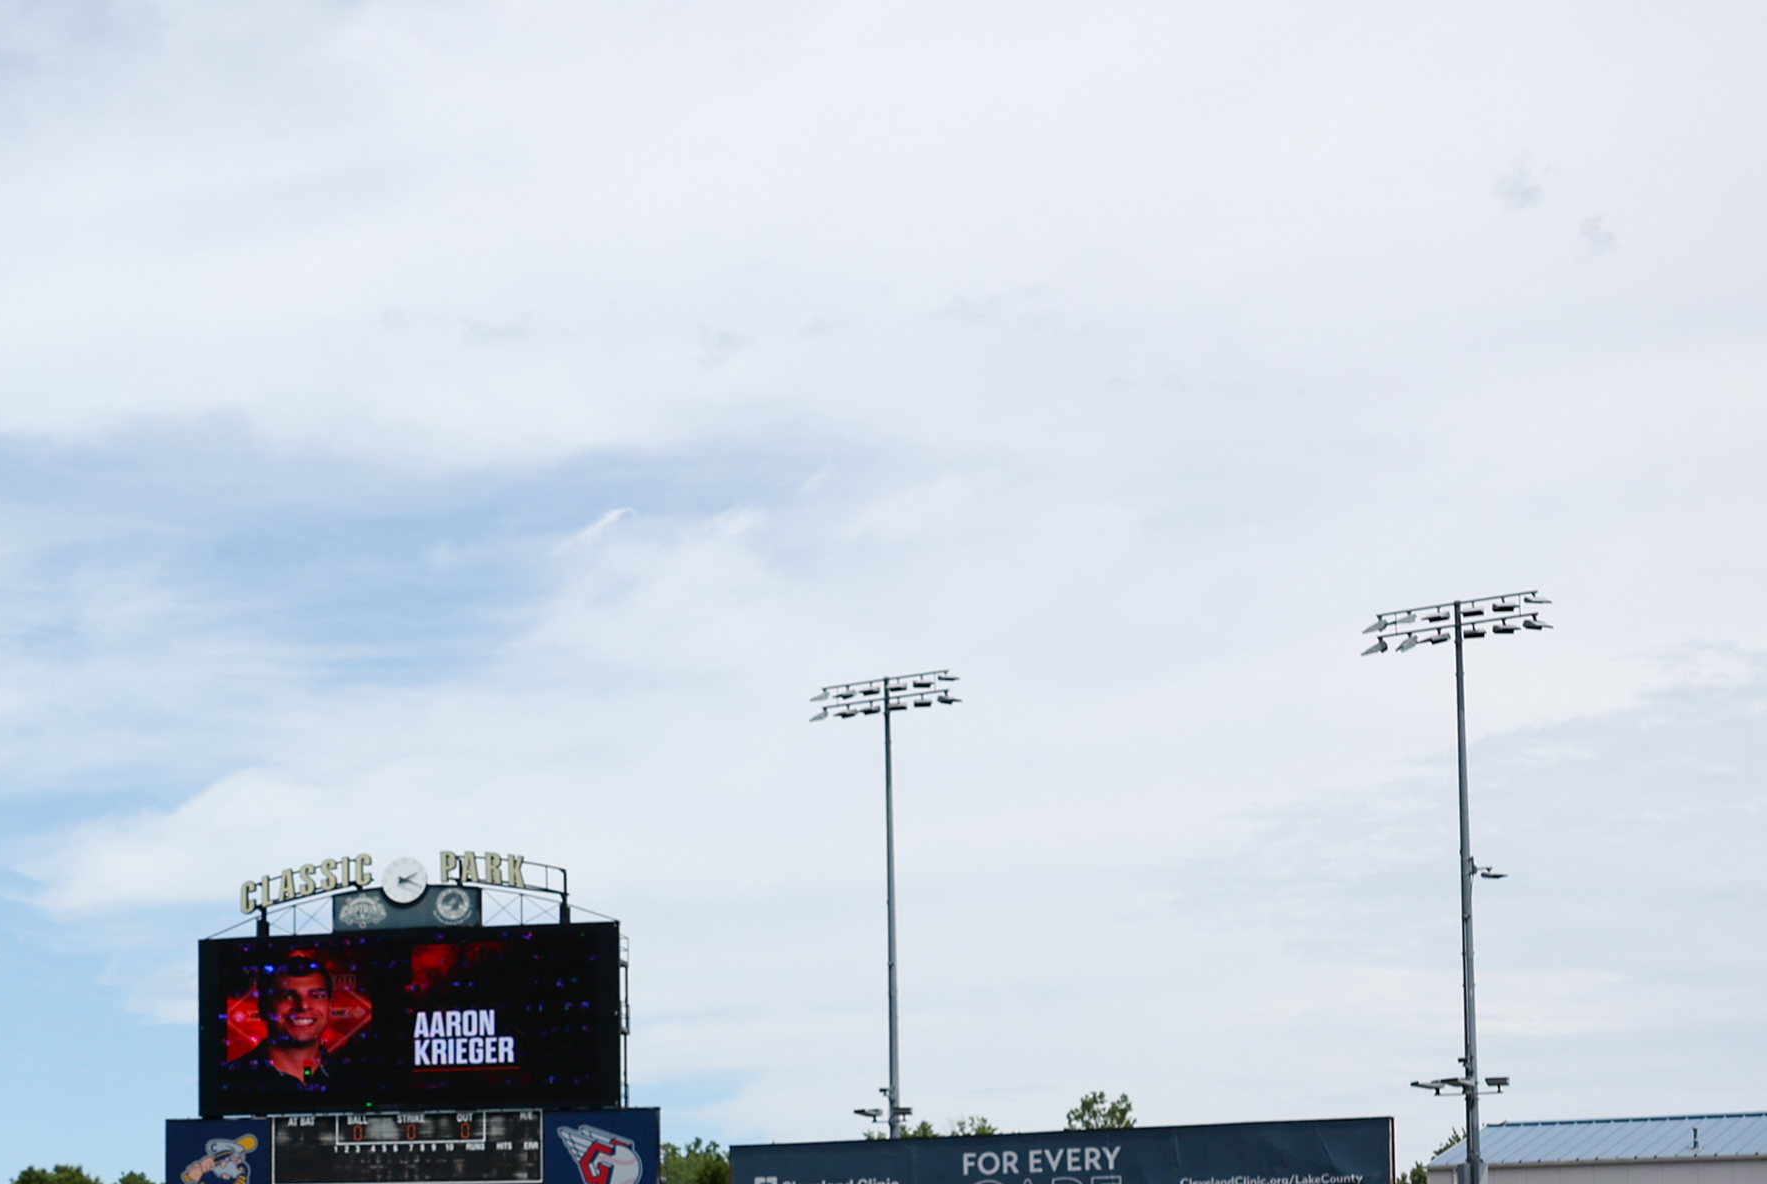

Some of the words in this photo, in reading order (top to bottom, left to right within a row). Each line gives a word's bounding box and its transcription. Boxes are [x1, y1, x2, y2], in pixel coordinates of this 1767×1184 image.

[241, 853, 372, 914] CLASSIC
[440, 851, 525, 888] PARK
[414, 1009, 495, 1038] AARON
[414, 1037, 514, 1066] KRIEGER
[287, 1118, 298, 1126] AT
[300, 1117, 315, 1126] BAT
[347, 1116, 368, 1125] BALL
[397, 1114, 425, 1124] STRIKE
[456, 1113, 473, 1123] OUT
[353, 1125, 363, 1141] 0
[407, 1124, 416, 1140] 0
[460, 1123, 470, 1139] 0
[445, 1143, 454, 1151] 10
[466, 1142, 485, 1151] RUNS
[496, 1142, 513, 1150] HITS
[523, 1141, 538, 1150] ERR
[963, 1151, 1019, 1176] FOR
[1029, 1146, 1121, 1173] EVERY
